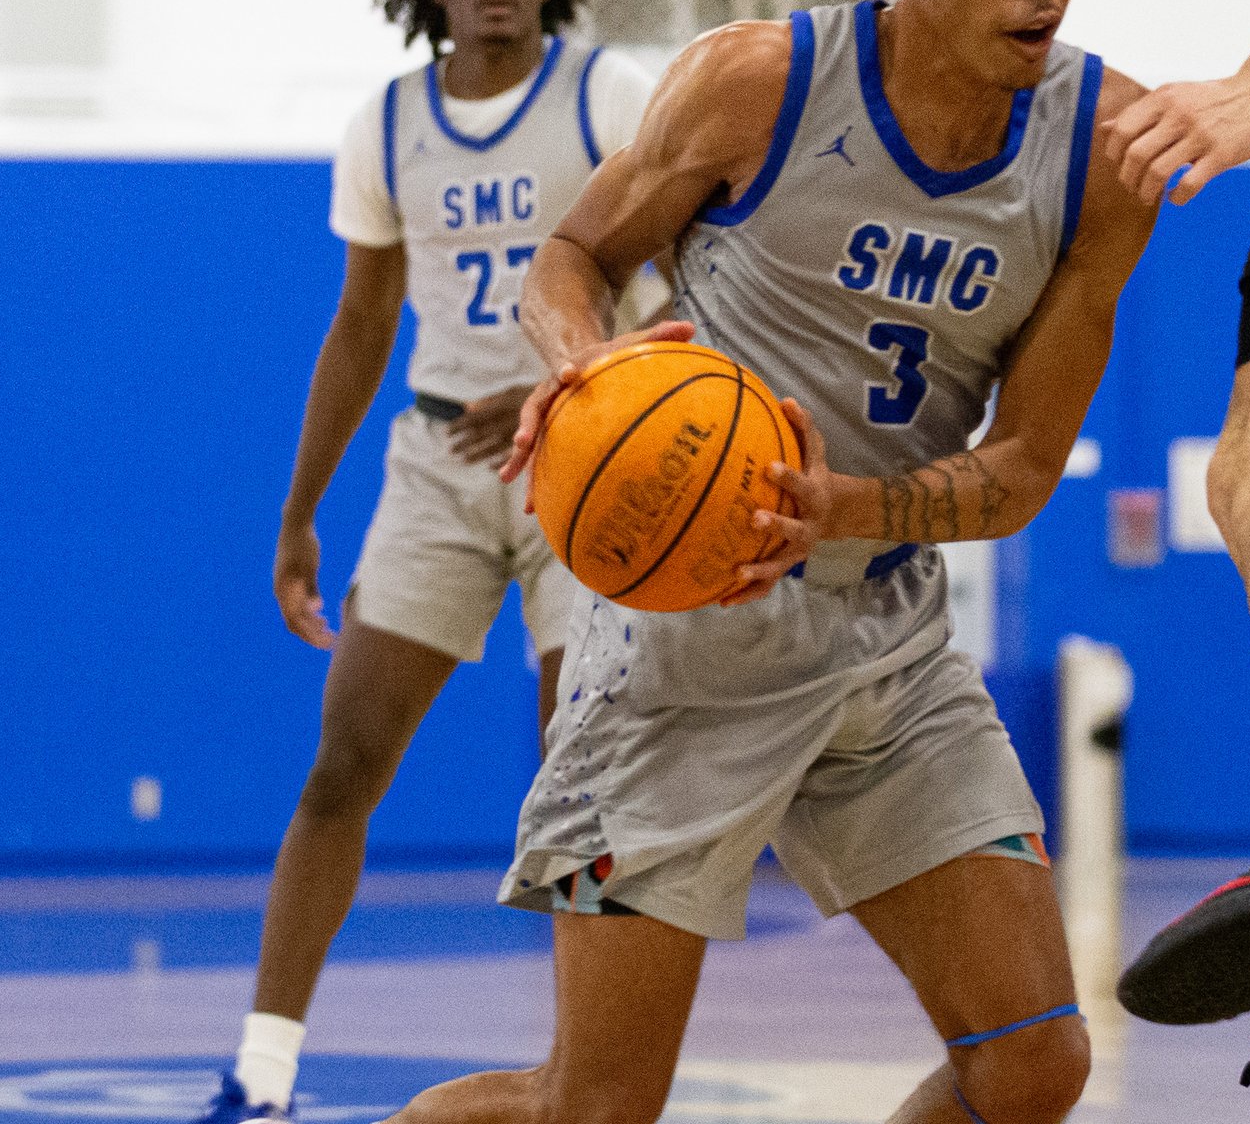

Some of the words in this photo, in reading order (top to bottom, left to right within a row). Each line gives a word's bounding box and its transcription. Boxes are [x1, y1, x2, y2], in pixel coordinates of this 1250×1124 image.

[442, 176, 534, 230] SMC
[836, 222, 1001, 313] SMC
[866, 321, 931, 426] 3
